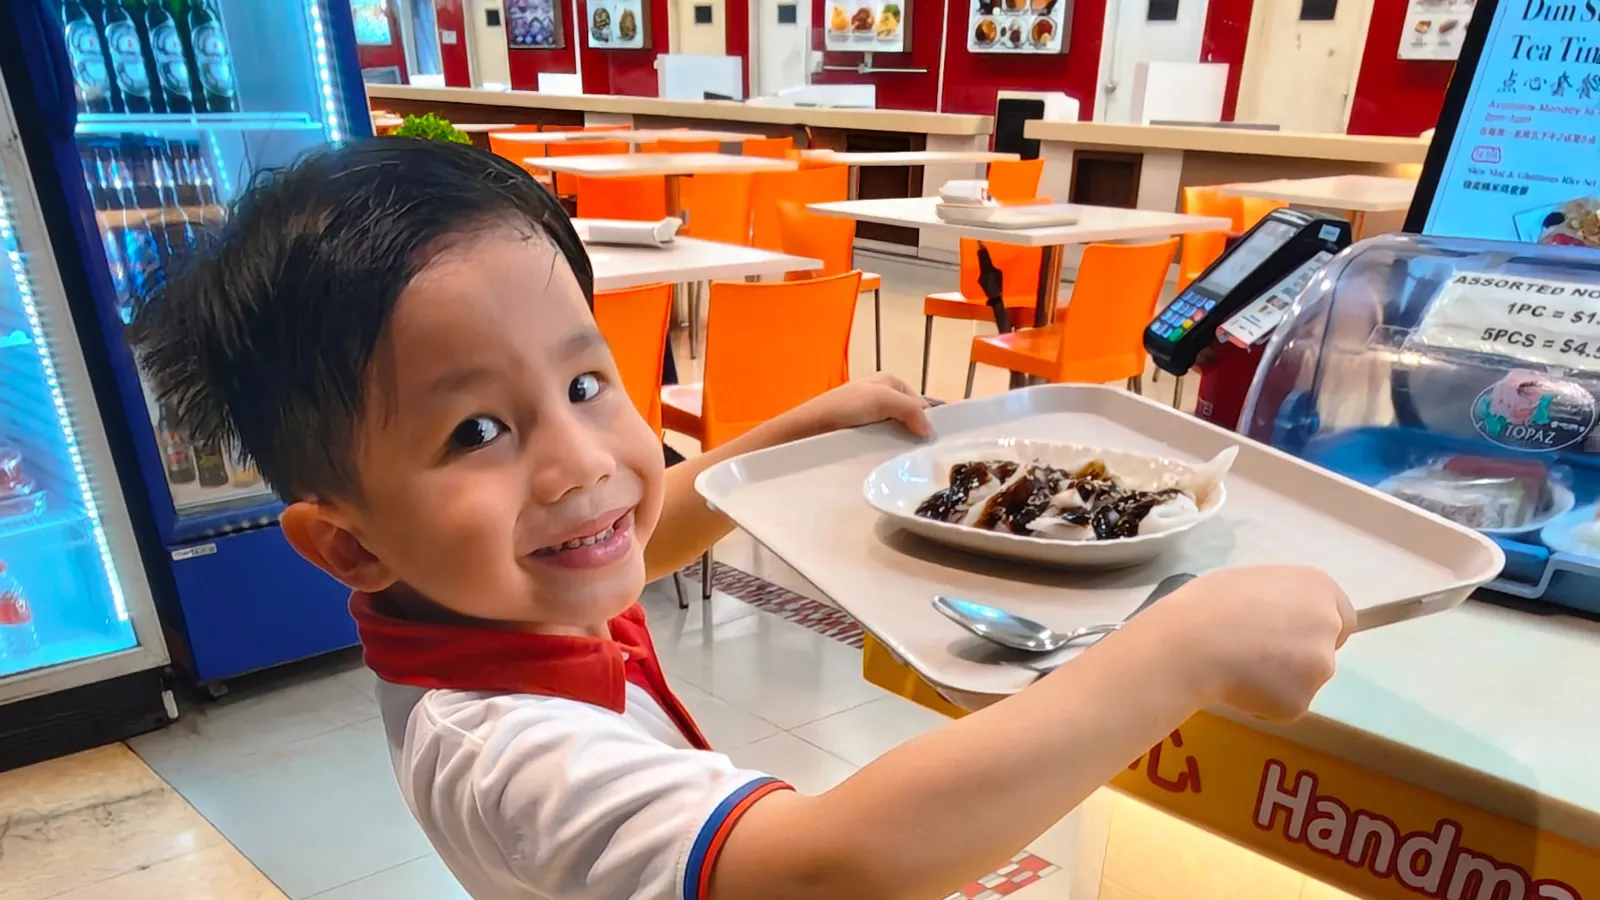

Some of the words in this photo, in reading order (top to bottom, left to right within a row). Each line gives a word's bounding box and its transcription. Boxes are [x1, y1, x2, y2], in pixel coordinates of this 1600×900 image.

[1522, 0, 1576, 22] Dim
[1580, 0, 1600, 22] S
[1511, 34, 1552, 62] Tea
[1453, 275, 1565, 296] ASSORTED
[1507, 301, 1547, 318] 1PC
[1552, 310, 1565, 319] =
[1481, 327, 1537, 348] 5PCS
[1542, 339, 1556, 348] =
